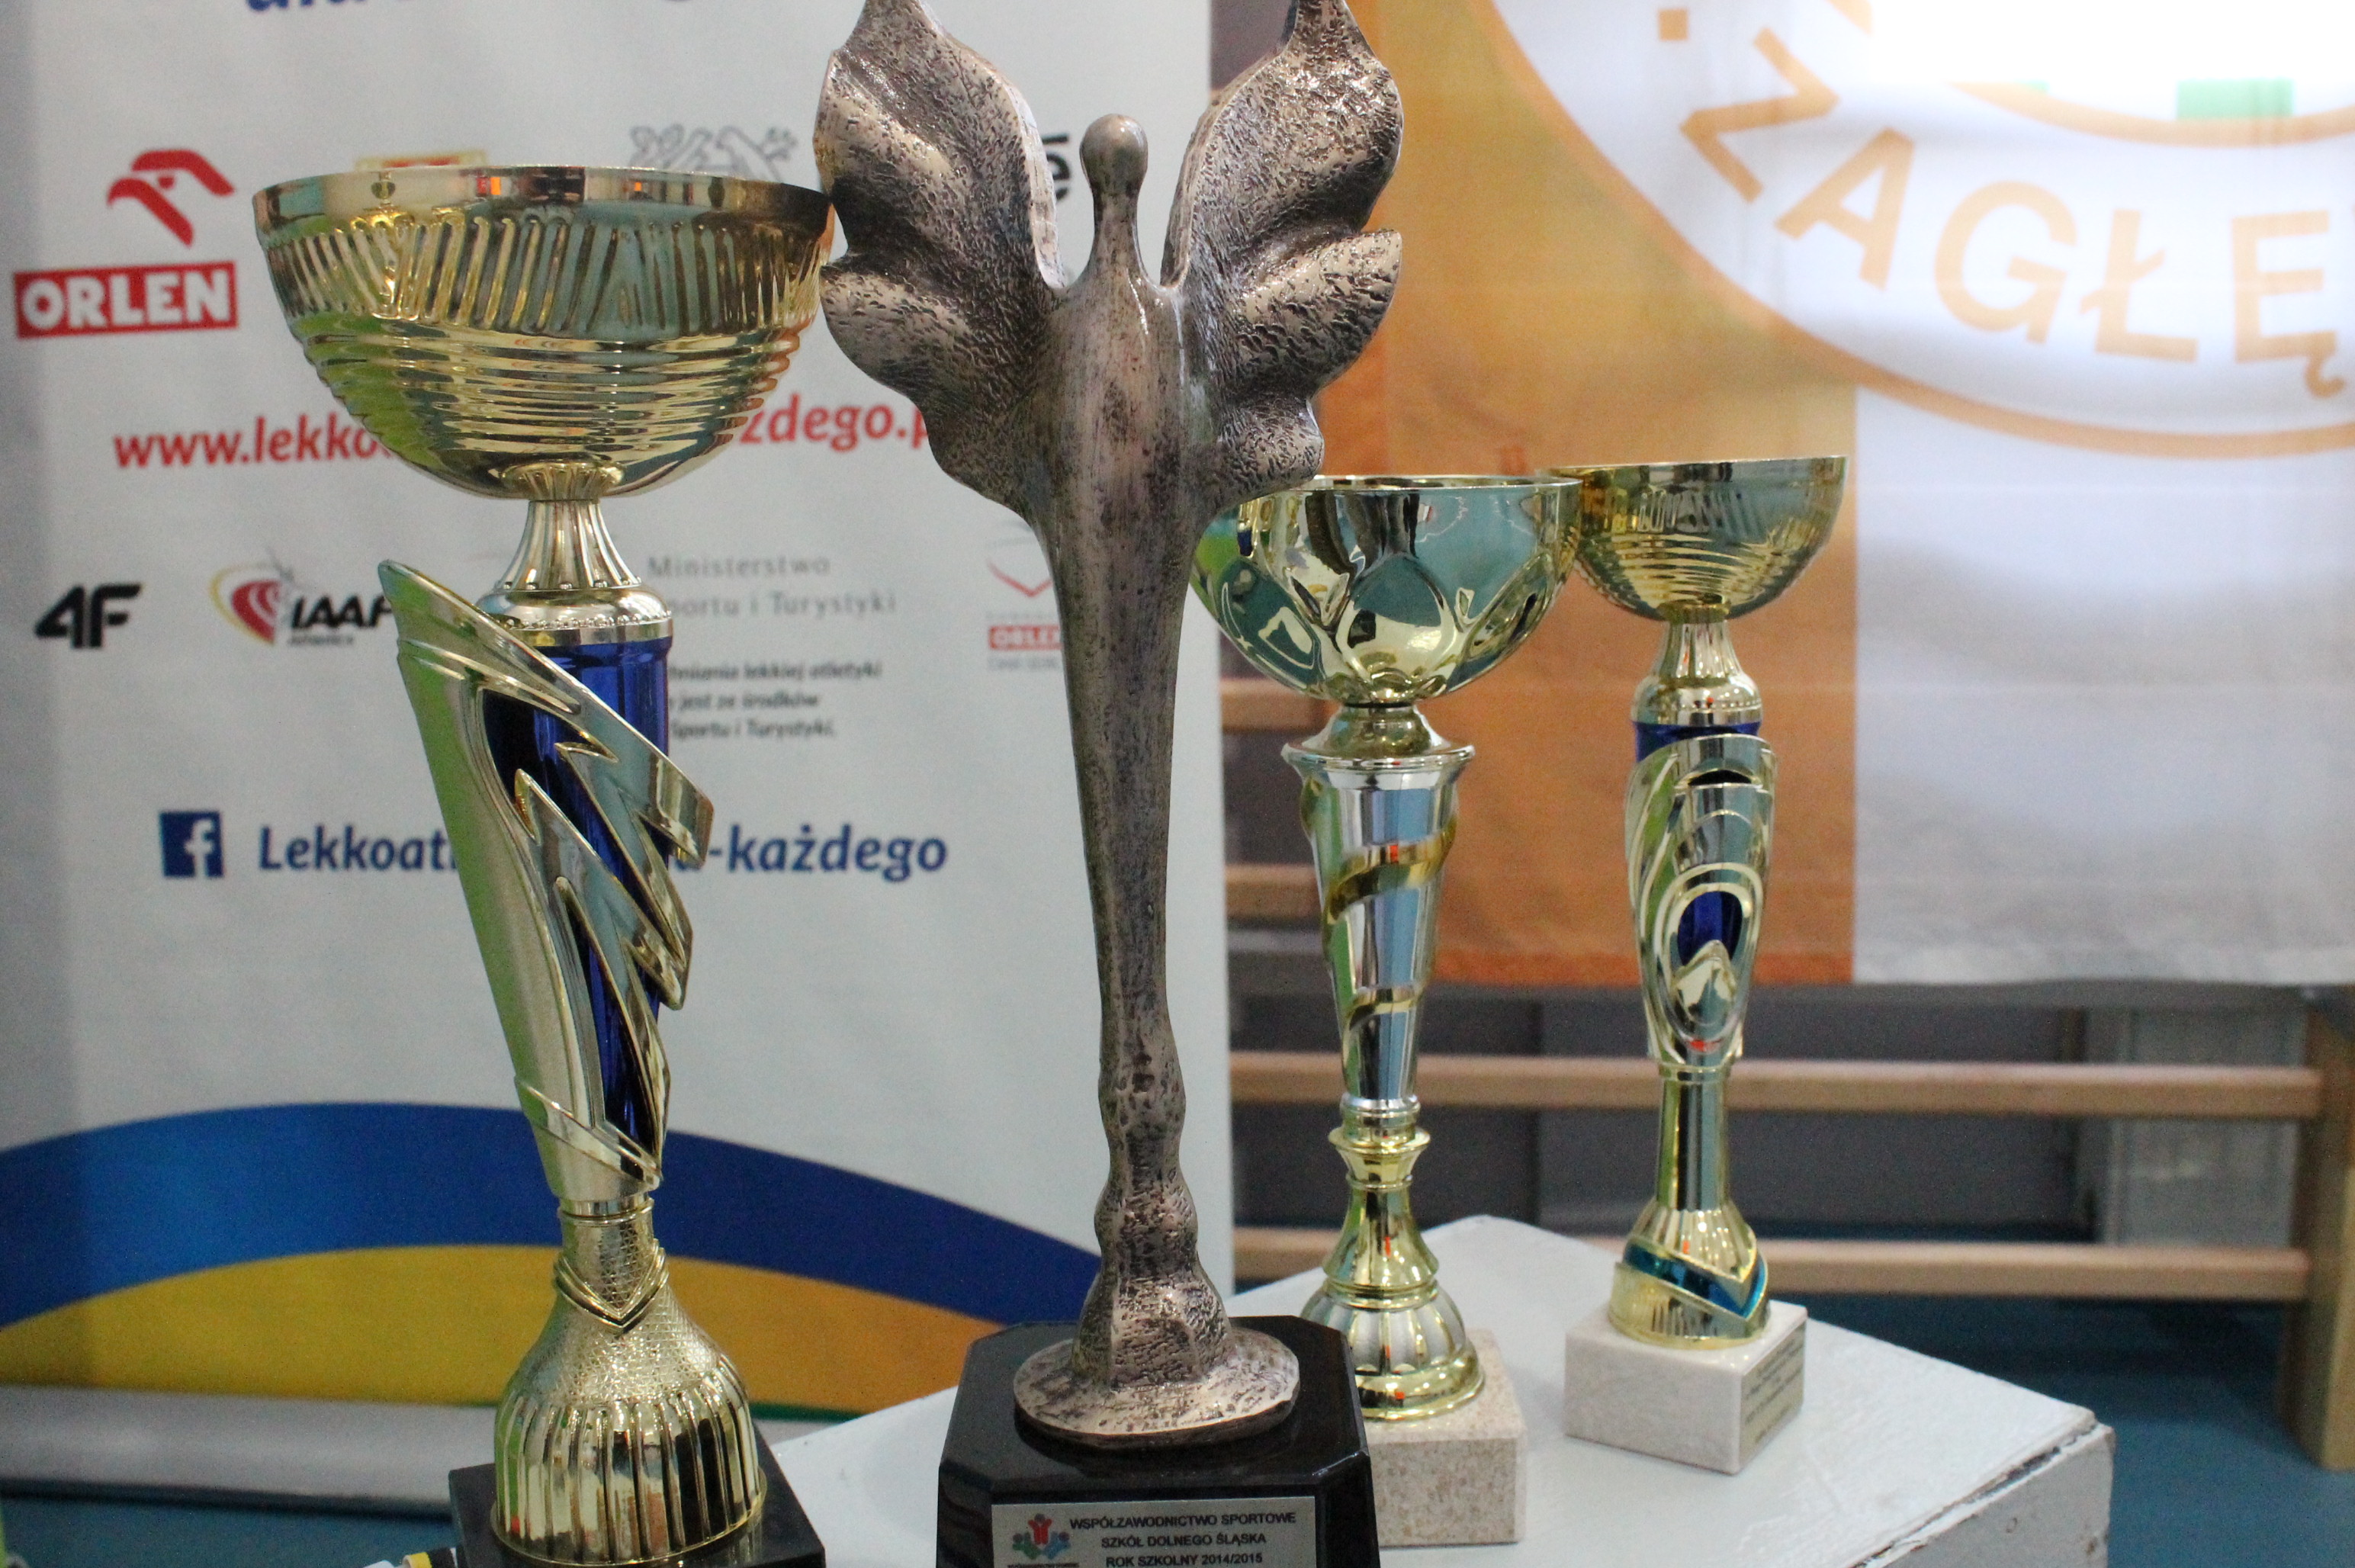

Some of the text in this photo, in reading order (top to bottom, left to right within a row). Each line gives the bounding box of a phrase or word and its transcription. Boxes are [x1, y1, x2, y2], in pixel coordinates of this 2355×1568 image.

[1679, 27, 2355, 398] ZAGŁĘ
[22, 269, 230, 329] ORLEN
[114, 412, 390, 468] www.lekko
[648, 555, 831, 577] Ministerstwo
[34, 583, 143, 649] 4F
[667, 595, 740, 617] portu
[771, 588, 896, 619] Turystyki
[259, 824, 458, 872] Lekkoat
[1069, 1512, 1296, 1530] WSPÓŁZAWODNICTWO SPORTOWE
[1101, 1532, 1267, 1548] SZKÓŁ DOLNEGO ŚLĄSKA
[1106, 1551, 1263, 1568] ROK SZKOLNY 2014/2015
